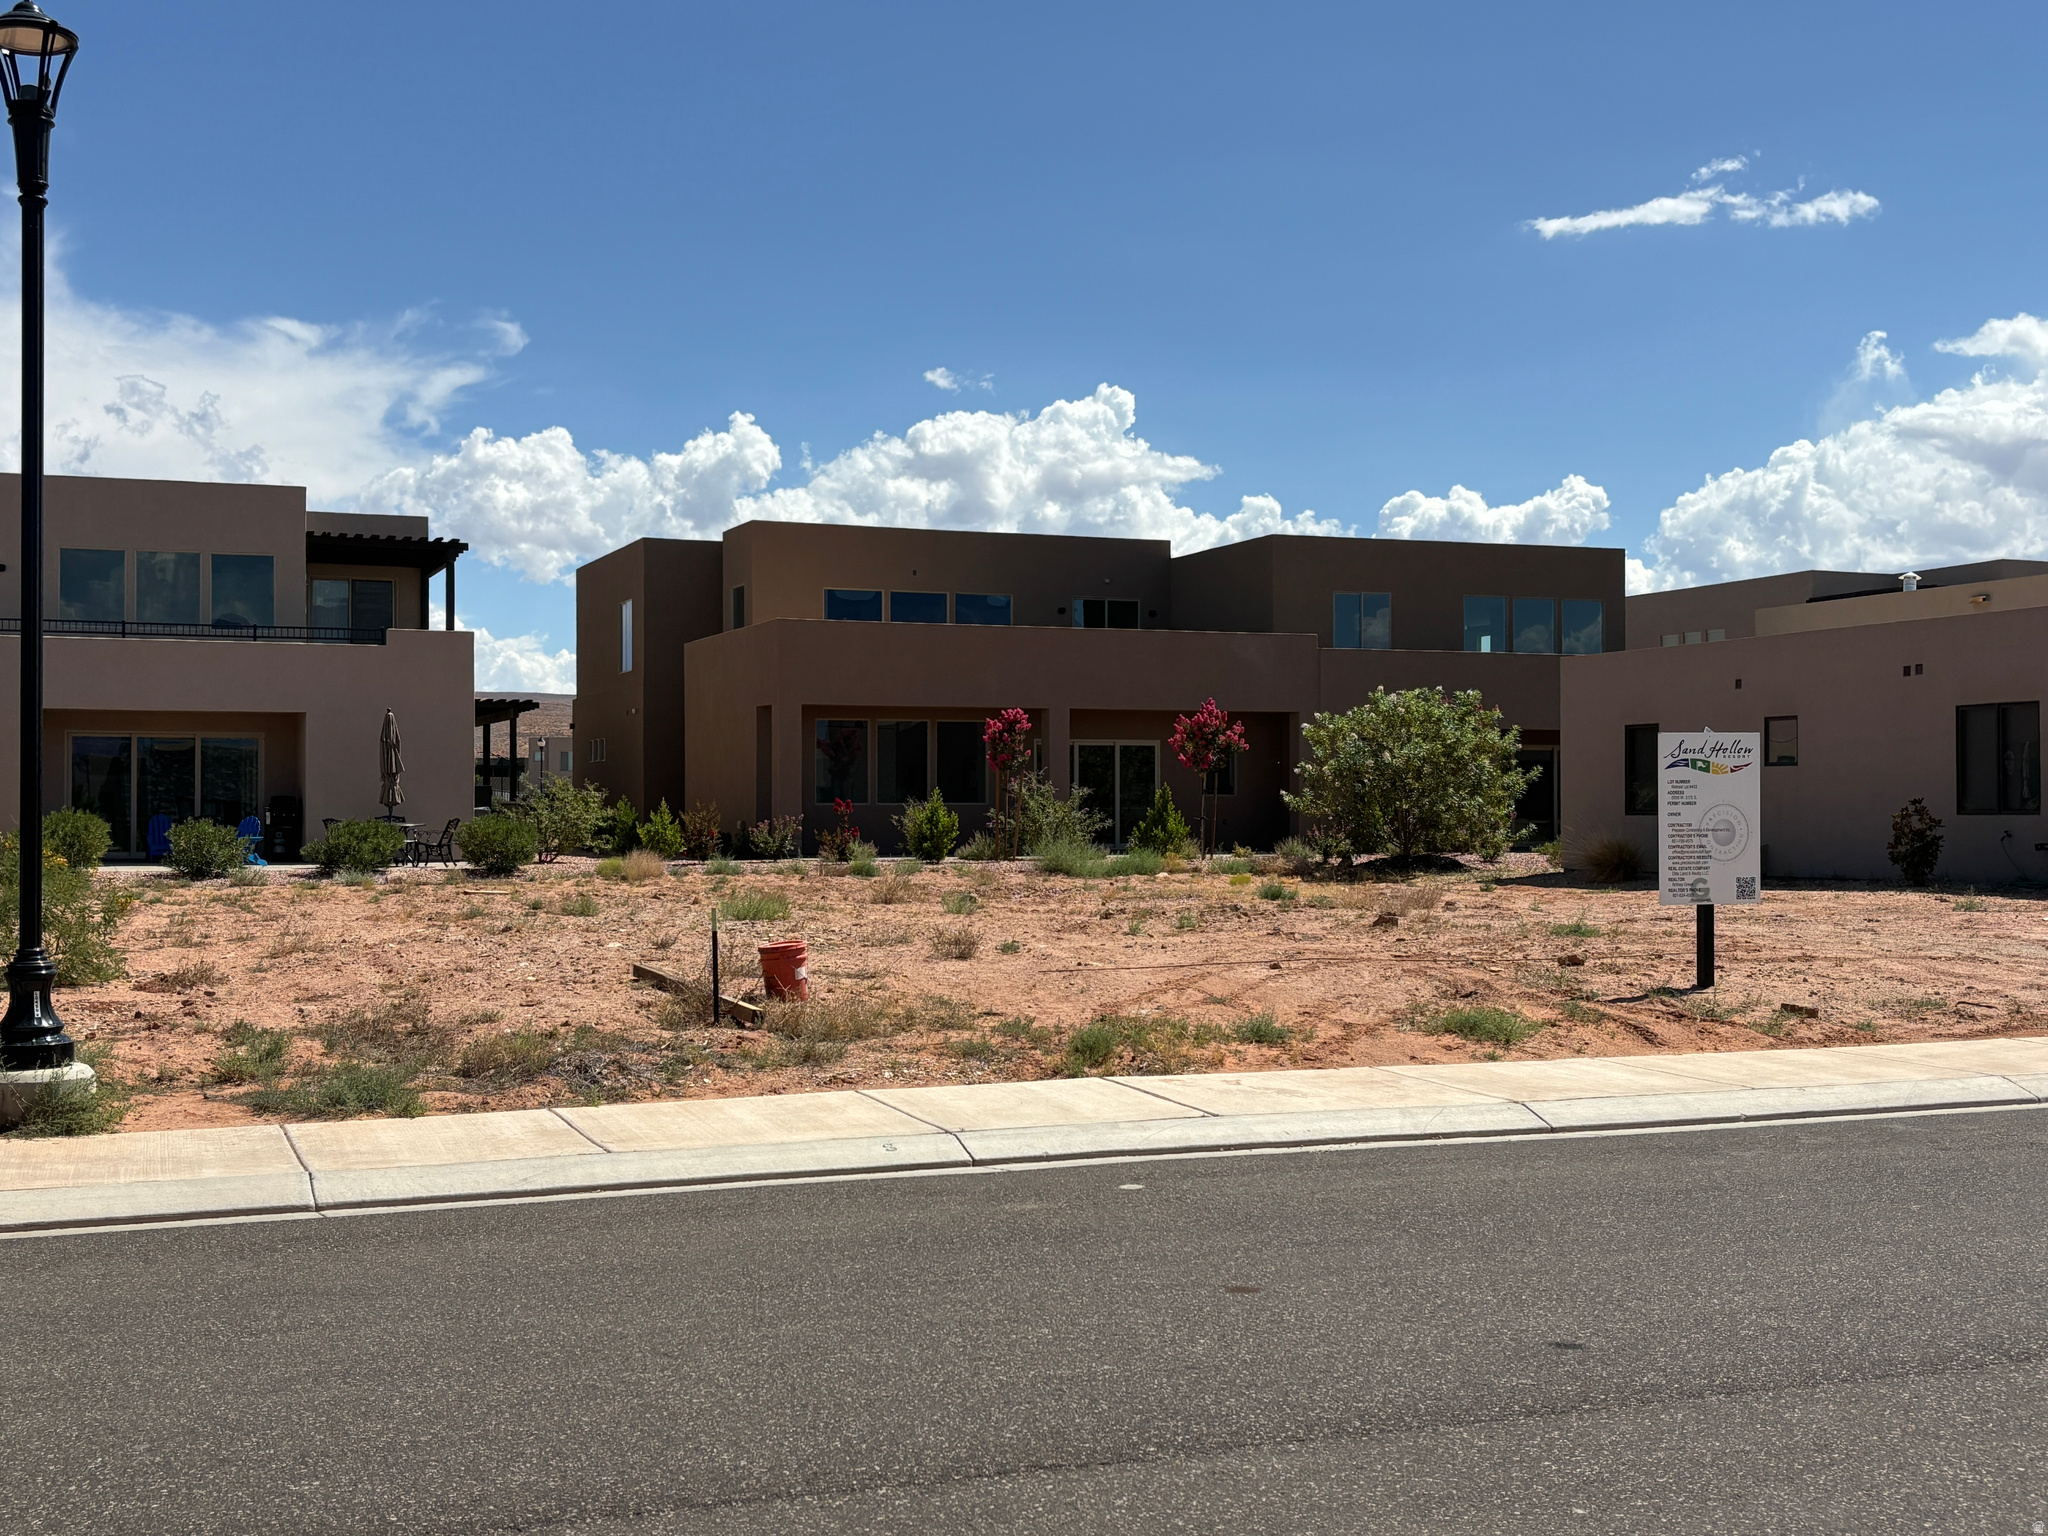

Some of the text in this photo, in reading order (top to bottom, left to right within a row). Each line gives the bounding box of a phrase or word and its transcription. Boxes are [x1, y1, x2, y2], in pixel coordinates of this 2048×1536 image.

[1663, 739, 1754, 759] Sand Hollow
[1705, 810, 1743, 827] PRECISION
